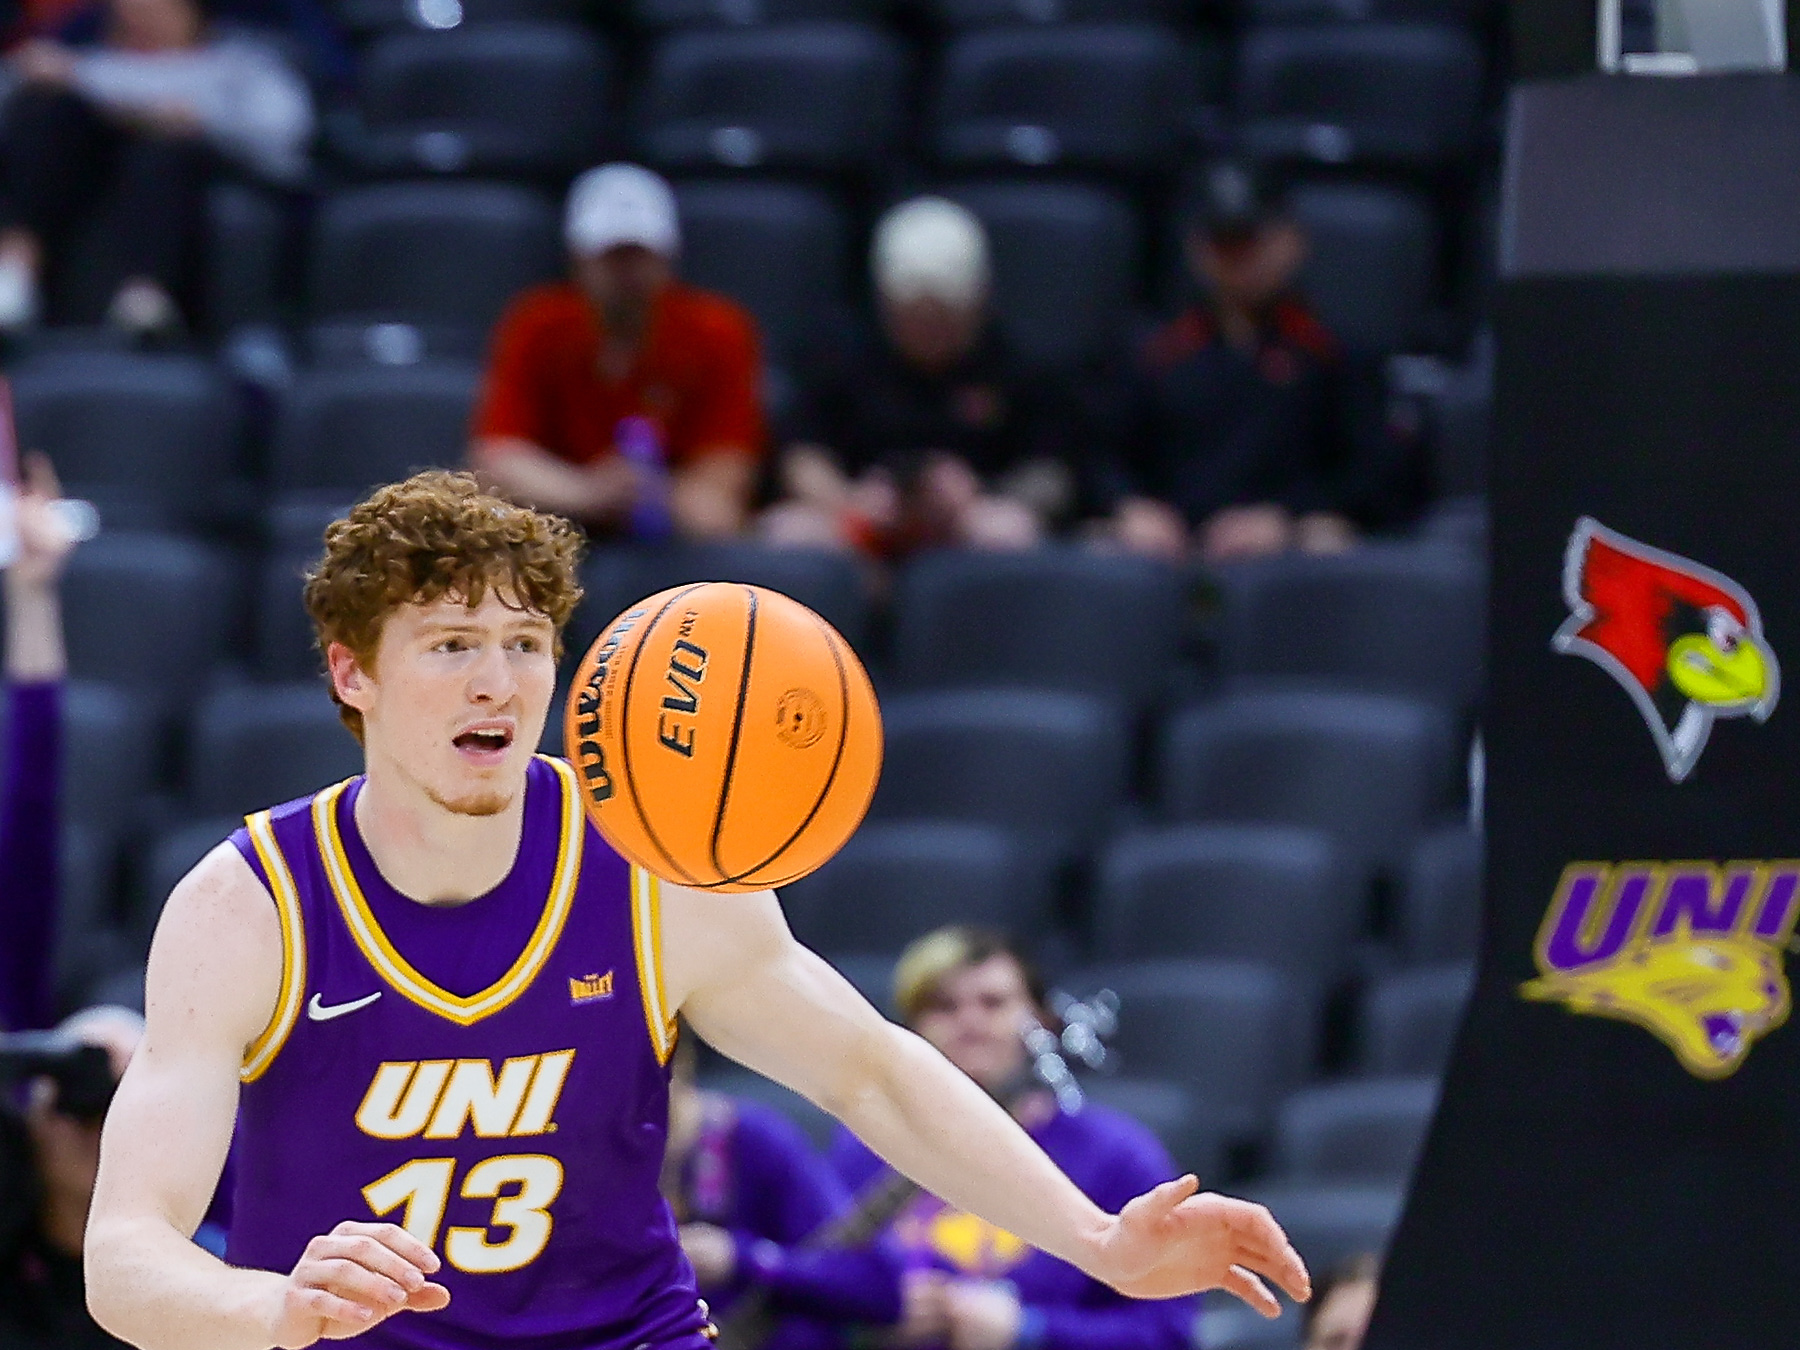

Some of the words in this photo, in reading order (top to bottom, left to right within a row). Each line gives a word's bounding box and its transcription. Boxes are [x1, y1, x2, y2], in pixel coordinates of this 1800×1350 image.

[658, 639, 710, 760] EVO
[1538, 863, 1800, 972] UNI
[354, 1048, 577, 1140] UNI
[360, 1153, 565, 1274] 13
